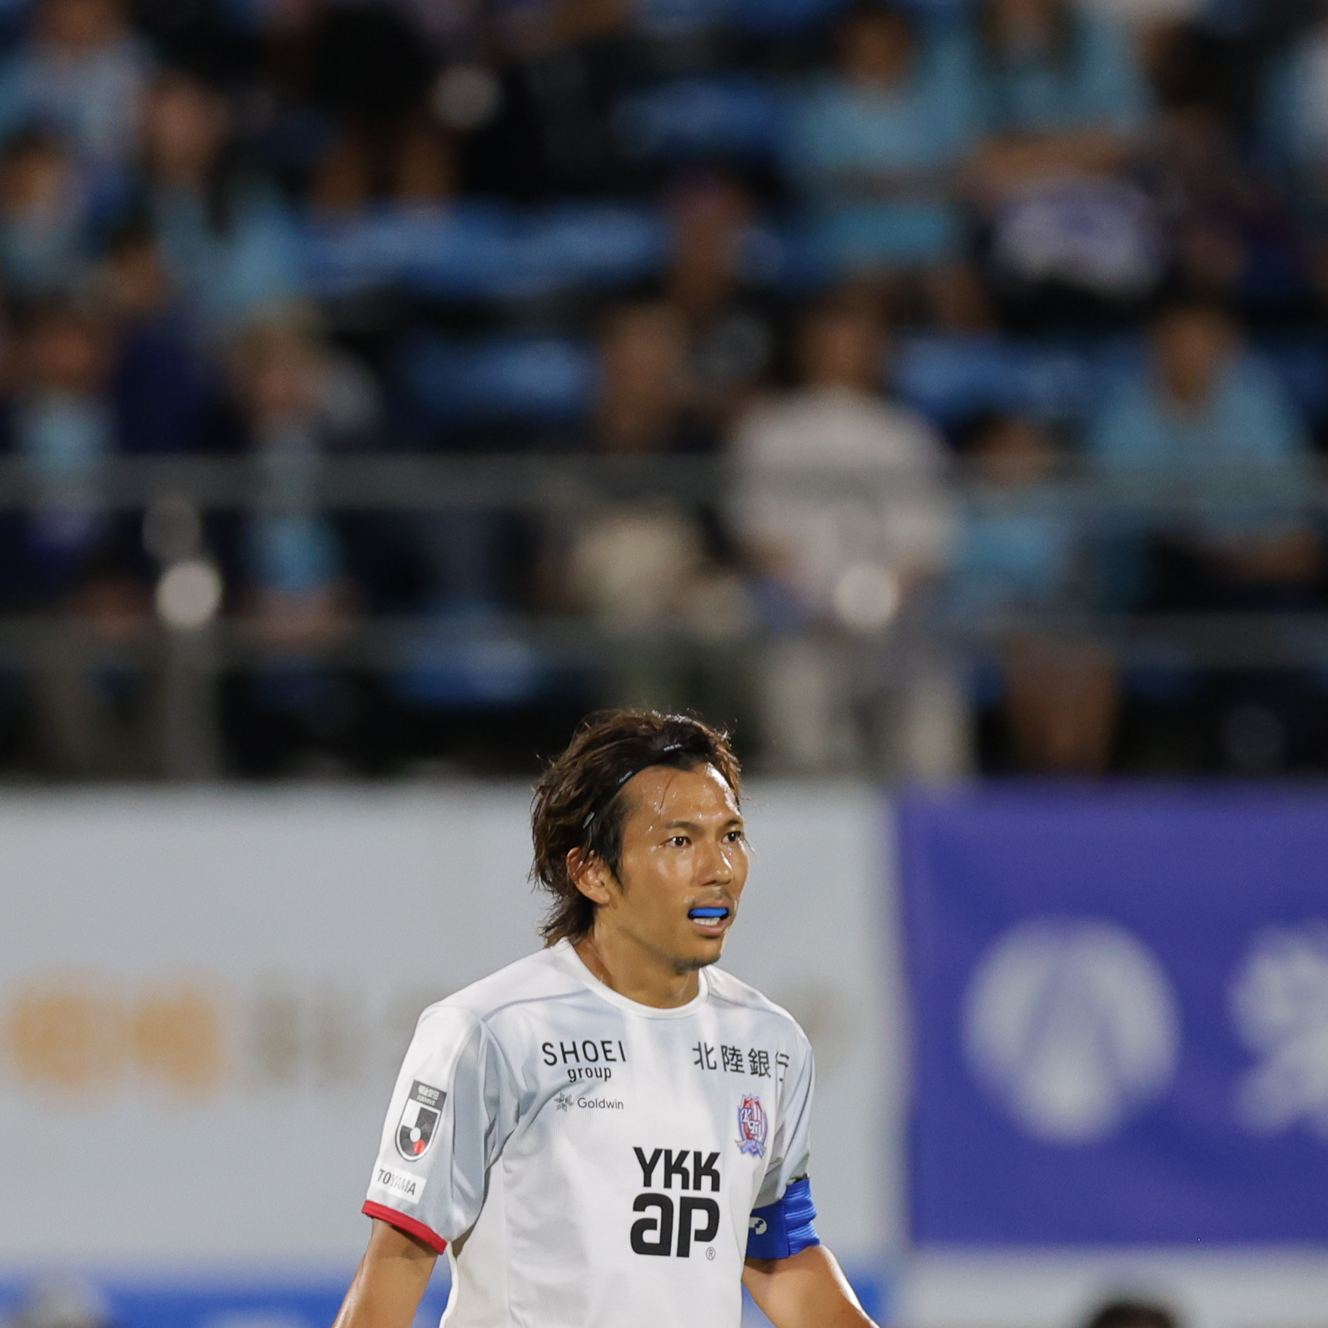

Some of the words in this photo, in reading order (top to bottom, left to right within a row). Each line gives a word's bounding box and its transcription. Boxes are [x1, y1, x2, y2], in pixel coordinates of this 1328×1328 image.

[541, 1039, 626, 1067] SHOEI
[692, 1041, 790, 1082] 北陸銀行
[567, 1066, 612, 1083] group
[577, 1097, 624, 1110] Goldwin
[376, 1168, 417, 1196] TOYAMA
[632, 1146, 721, 1192] YKK
